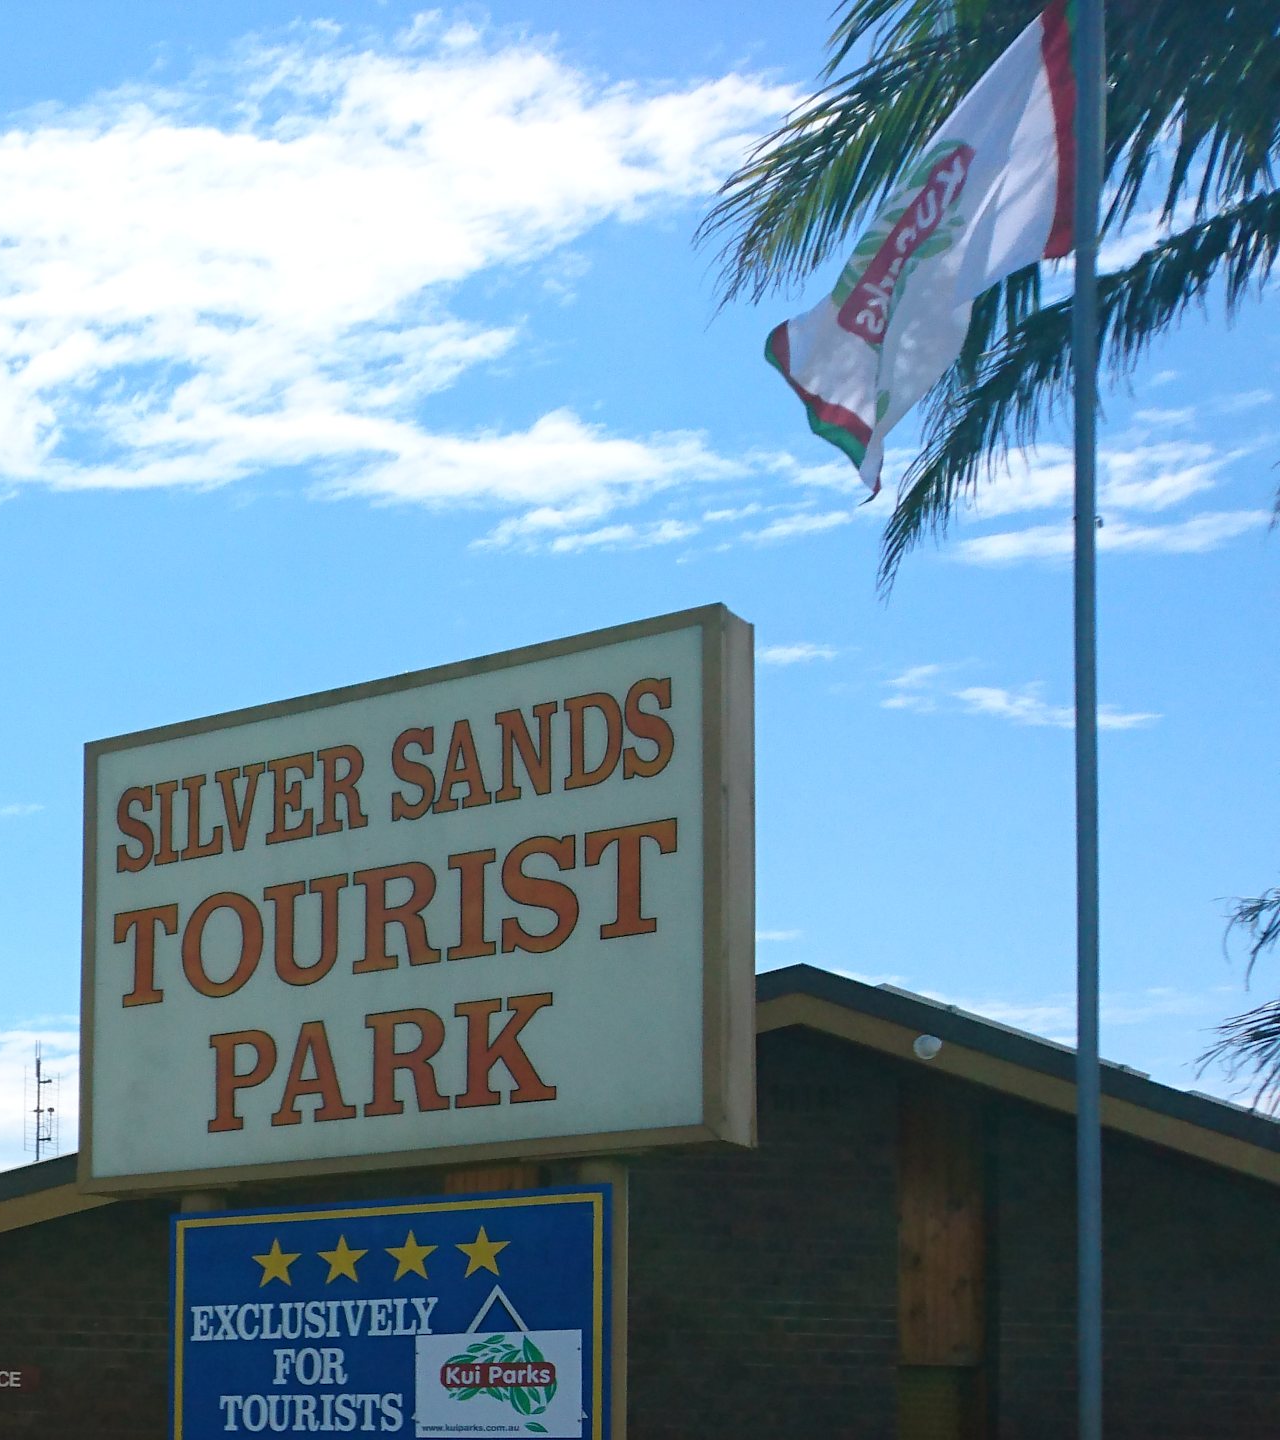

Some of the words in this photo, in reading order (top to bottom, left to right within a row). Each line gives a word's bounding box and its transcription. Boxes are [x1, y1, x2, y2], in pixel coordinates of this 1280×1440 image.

[117, 745, 367, 872] SILVER
[392, 678, 675, 822] SANDS
[114, 818, 677, 1008] TOURIST
[208, 993, 557, 1133] PARK
[190, 1297, 438, 1343] EXCLUSIVELY
[272, 1348, 348, 1385] FOR
[446, 1366, 480, 1384] Kui
[489, 1366, 550, 1385] Parks
[219, 1393, 403, 1432] TOURISTS
[422, 1423, 519, 1433] www.kuiparks.com.au
